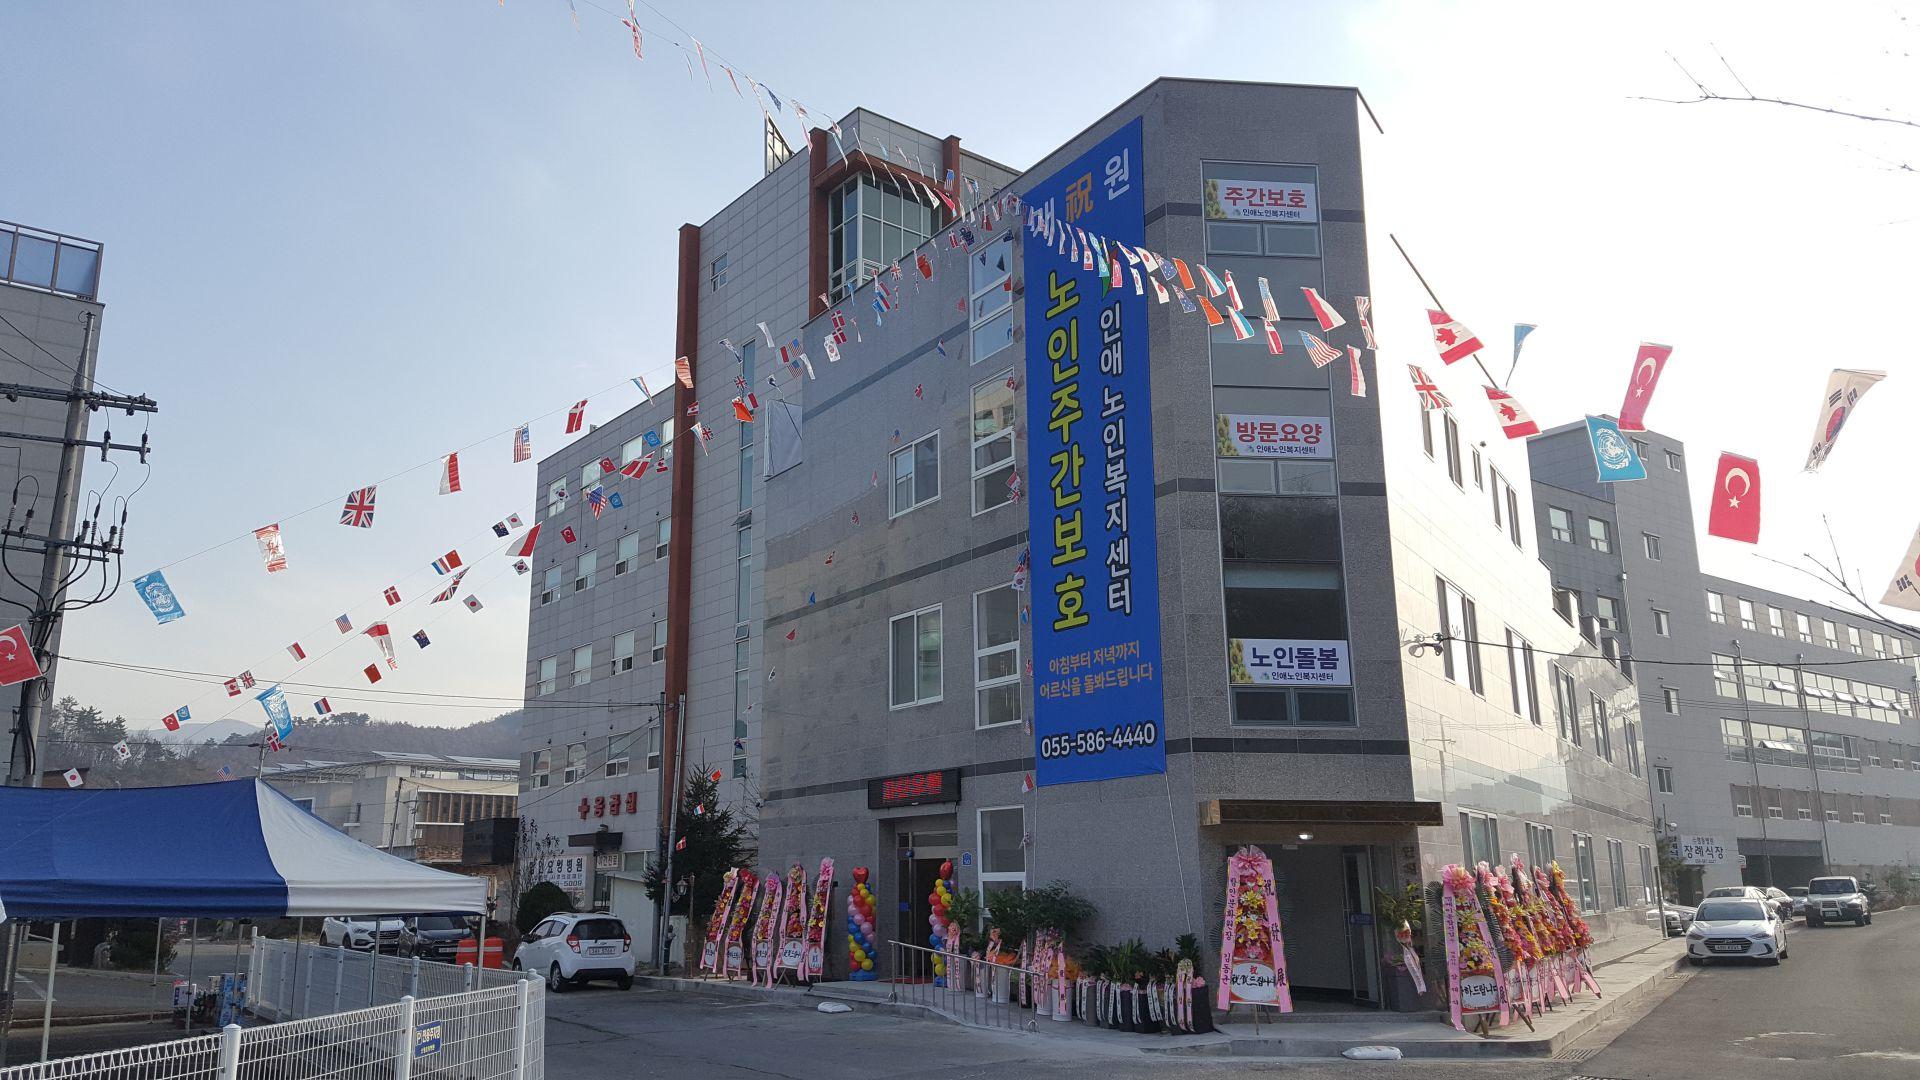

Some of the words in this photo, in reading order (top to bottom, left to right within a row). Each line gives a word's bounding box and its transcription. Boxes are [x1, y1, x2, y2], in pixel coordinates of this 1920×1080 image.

[1065, 172, 1094, 222] 祝
[1104, 148, 1130, 200] 원
[1224, 186, 1308, 209] 주간보호
[1242, 208, 1301, 219] 인애노인복지센터
[1236, 421, 1323, 445] 방문요양
[1045, 270, 1089, 631] 노인주간보호
[1256, 444, 1316, 455] 인애노인복지센터
[1048, 651, 1091, 675] 아침부터
[1093, 640, 1140, 665] 저녁까지
[1250, 646, 1339, 670] 노인돌봄
[1039, 676, 1082, 699] 어르신을
[1084, 662, 1153, 694] 돌봐드립니다
[1271, 671, 1334, 682] 인애노인복지센터
[1041, 723, 1156, 759] 055-586-4440
[593, 791, 638, 818] 응급실
[1683, 845, 1724, 860] 장례식장
